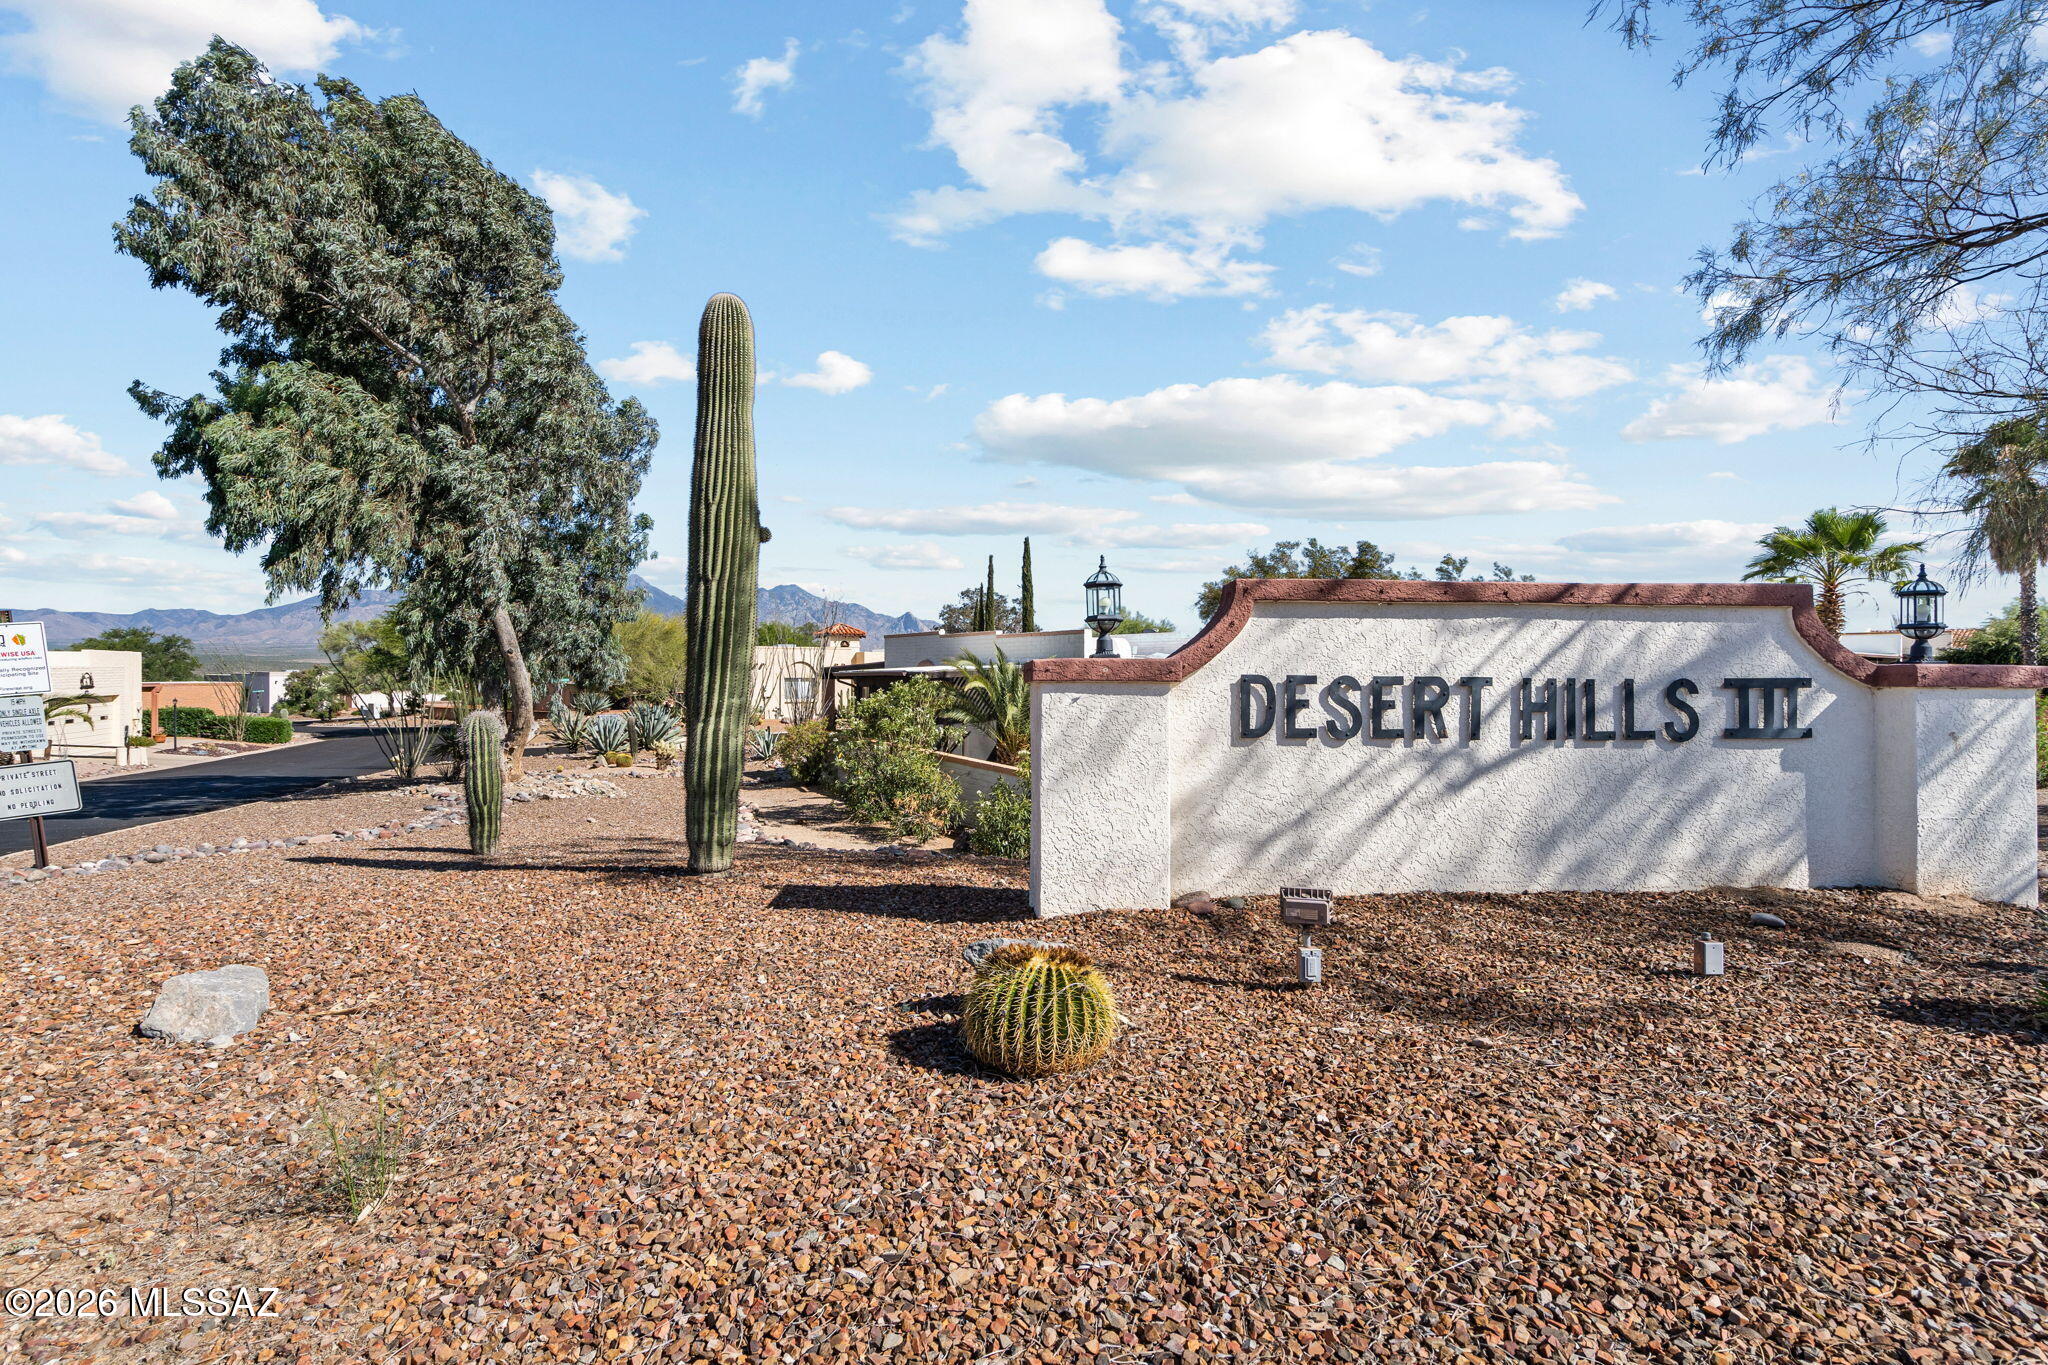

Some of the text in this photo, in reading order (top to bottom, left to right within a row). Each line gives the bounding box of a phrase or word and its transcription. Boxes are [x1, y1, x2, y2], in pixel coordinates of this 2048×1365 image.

[12, 708, 28, 717] SINGLE
[29, 707, 40, 716] AXLE
[1240, 674, 1813, 743] DESERT HILLS III
[22, 717, 42, 726] ALLOWED
[31, 769, 57, 777] STREET
[10, 783, 62, 795] SOLICITATION
[20, 799, 55, 809] PEDDLING
